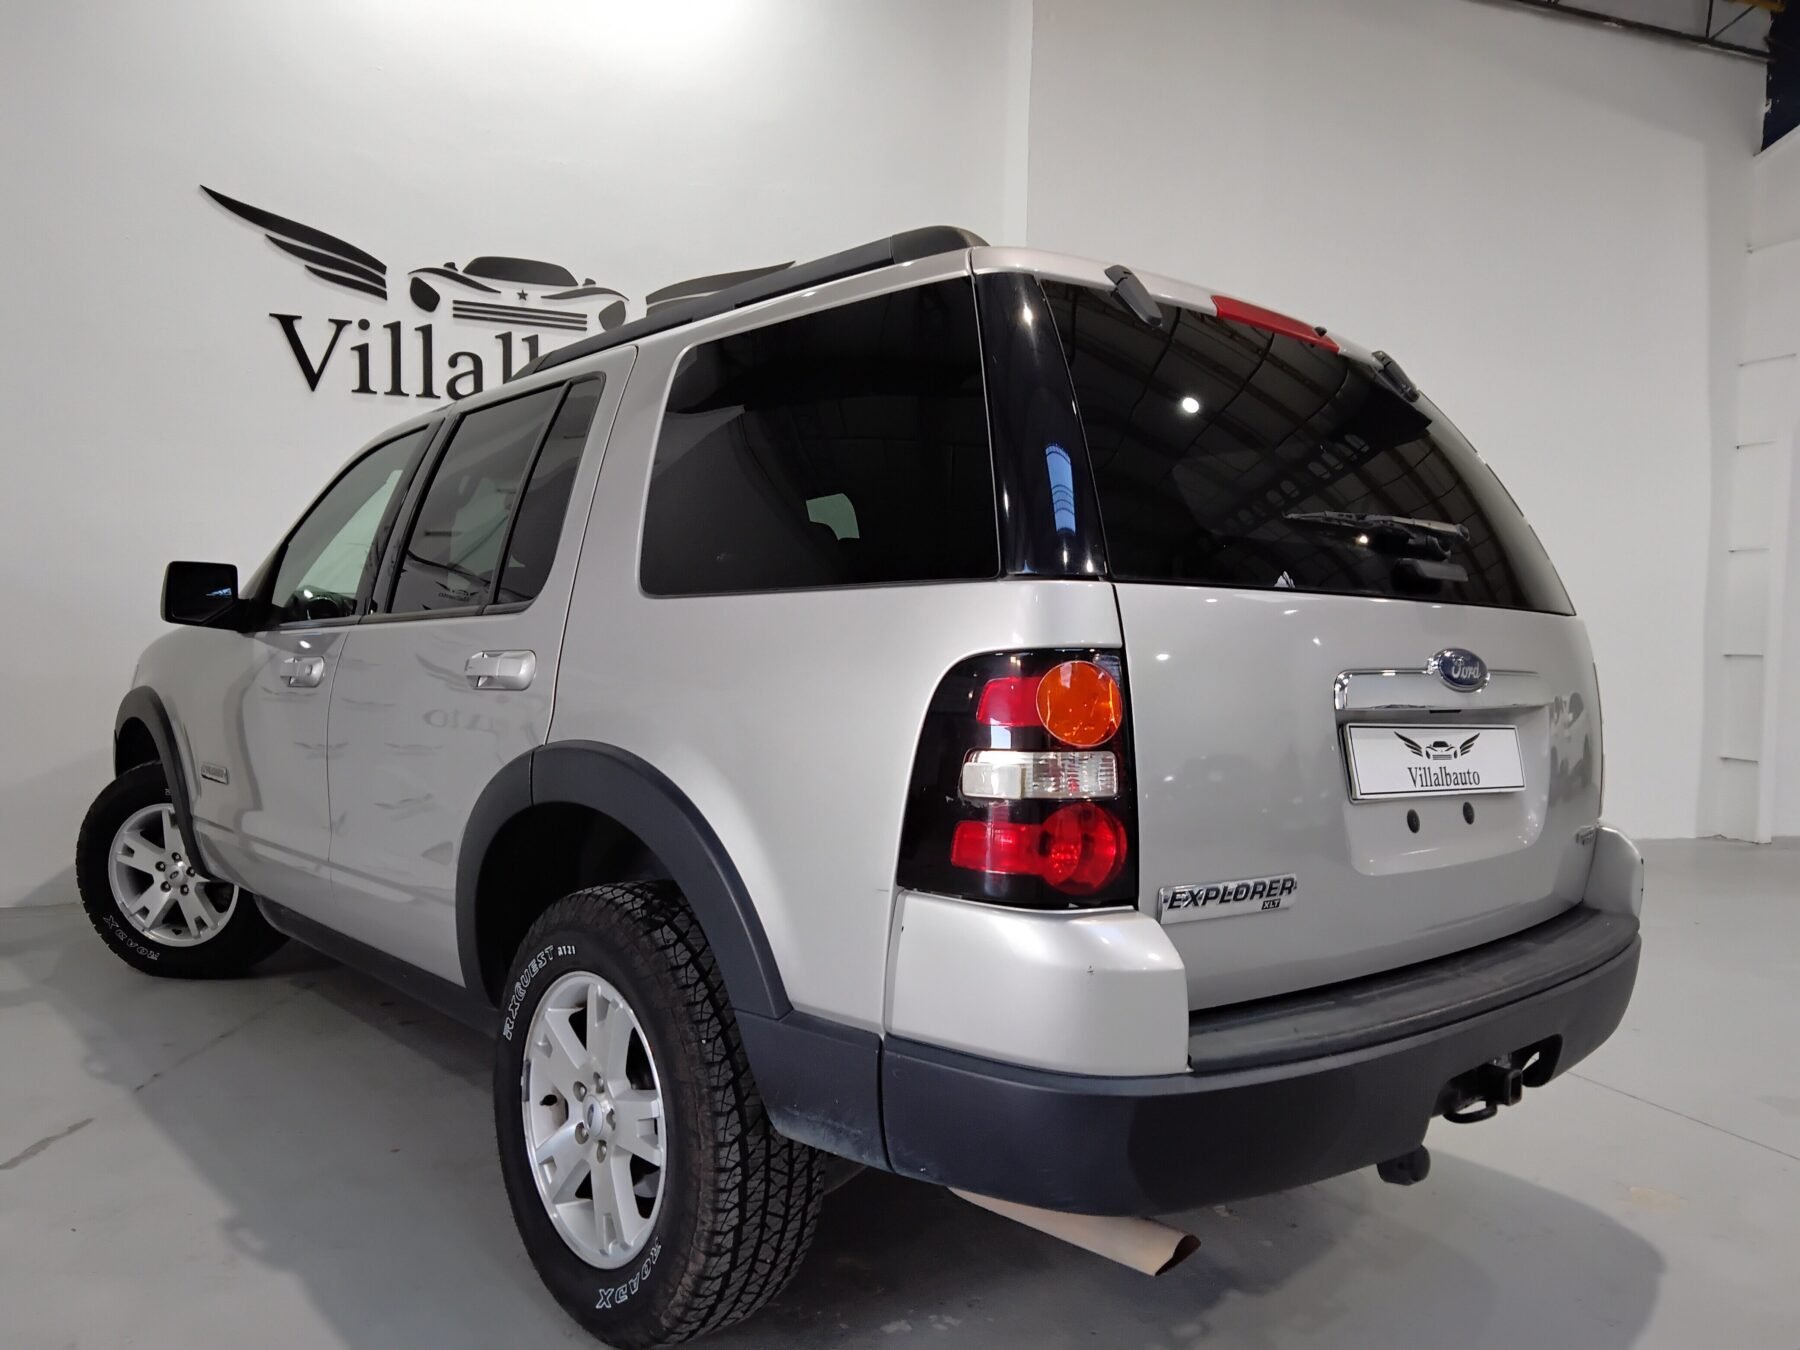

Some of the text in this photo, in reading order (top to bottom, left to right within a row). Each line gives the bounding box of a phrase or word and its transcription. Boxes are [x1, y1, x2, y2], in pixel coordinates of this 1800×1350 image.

[1451, 656, 1482, 679] Ford
[1407, 766, 1481, 788] Villalbauto
[1166, 876, 1298, 909] EXPLORER
[1261, 899, 1281, 910] XLT
[503, 945, 554, 1040] RXQUEST
[595, 1236, 662, 1309] ROADX
